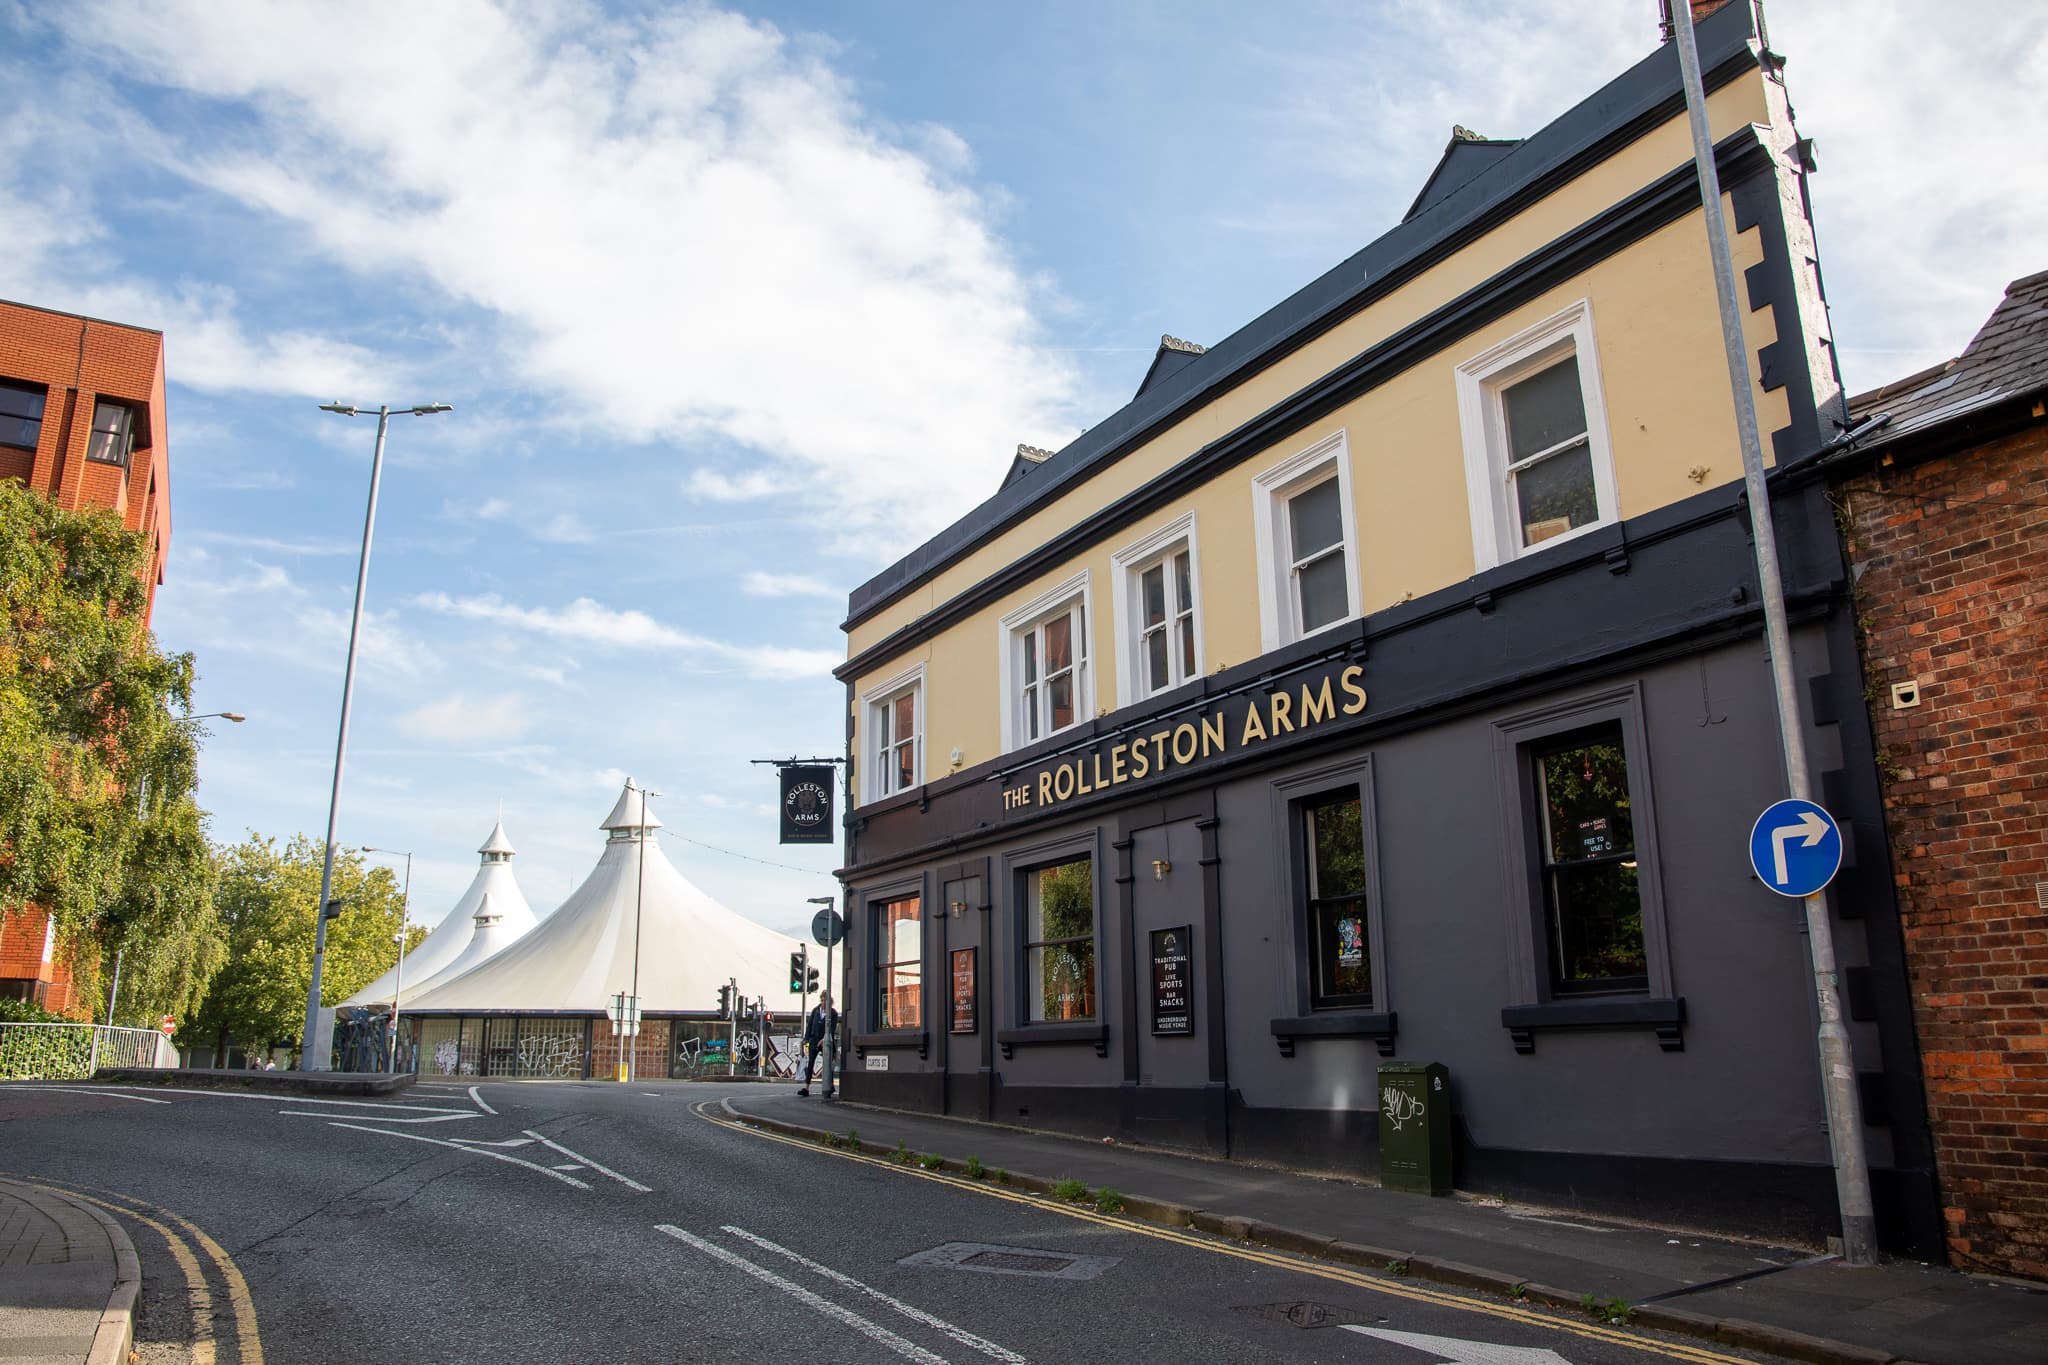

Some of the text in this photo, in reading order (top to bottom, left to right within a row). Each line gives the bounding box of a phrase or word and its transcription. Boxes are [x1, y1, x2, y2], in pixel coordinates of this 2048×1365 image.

[1003, 665, 1367, 810] THE ROLLESTON ARMS
[787, 784, 827, 805] ROLLESTON
[1155, 955, 1187, 964] TRADITIONAL
[1160, 980, 1182, 989] SPORTS
[1160, 998, 1184, 1007] SNACKS
